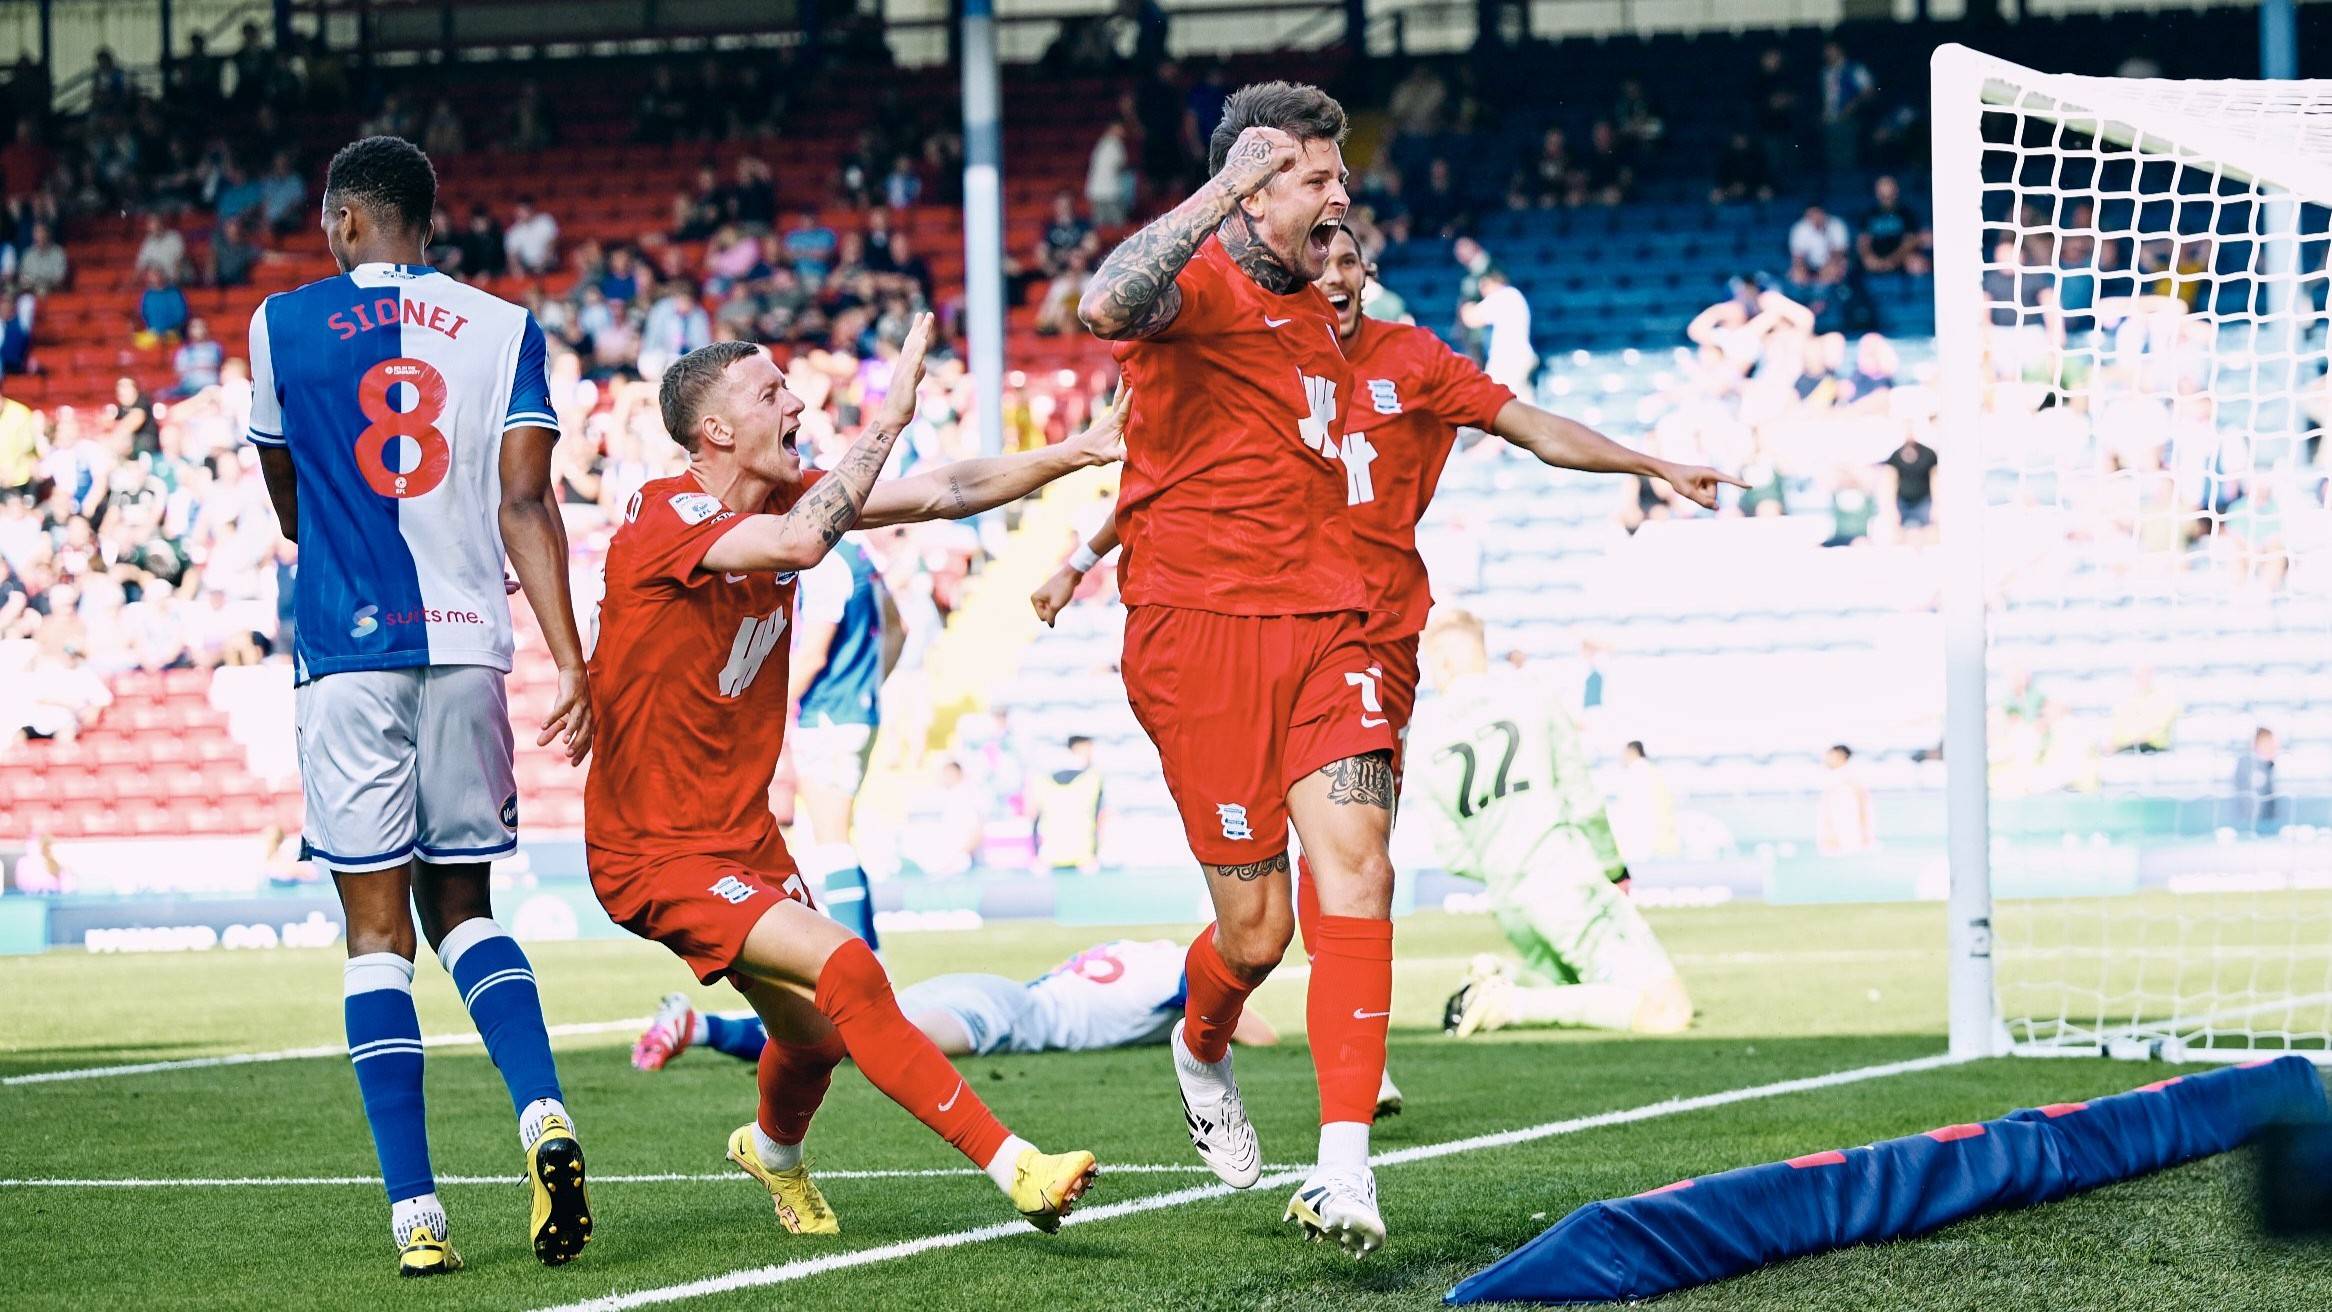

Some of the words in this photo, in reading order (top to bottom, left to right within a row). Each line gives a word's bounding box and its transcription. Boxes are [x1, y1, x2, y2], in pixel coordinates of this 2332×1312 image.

[328, 298, 469, 340] SIDNEI
[354, 357, 450, 498] 8
[386, 607, 442, 626] suits
[1344, 667, 1383, 712] 7
[1432, 720, 1530, 818] 22
